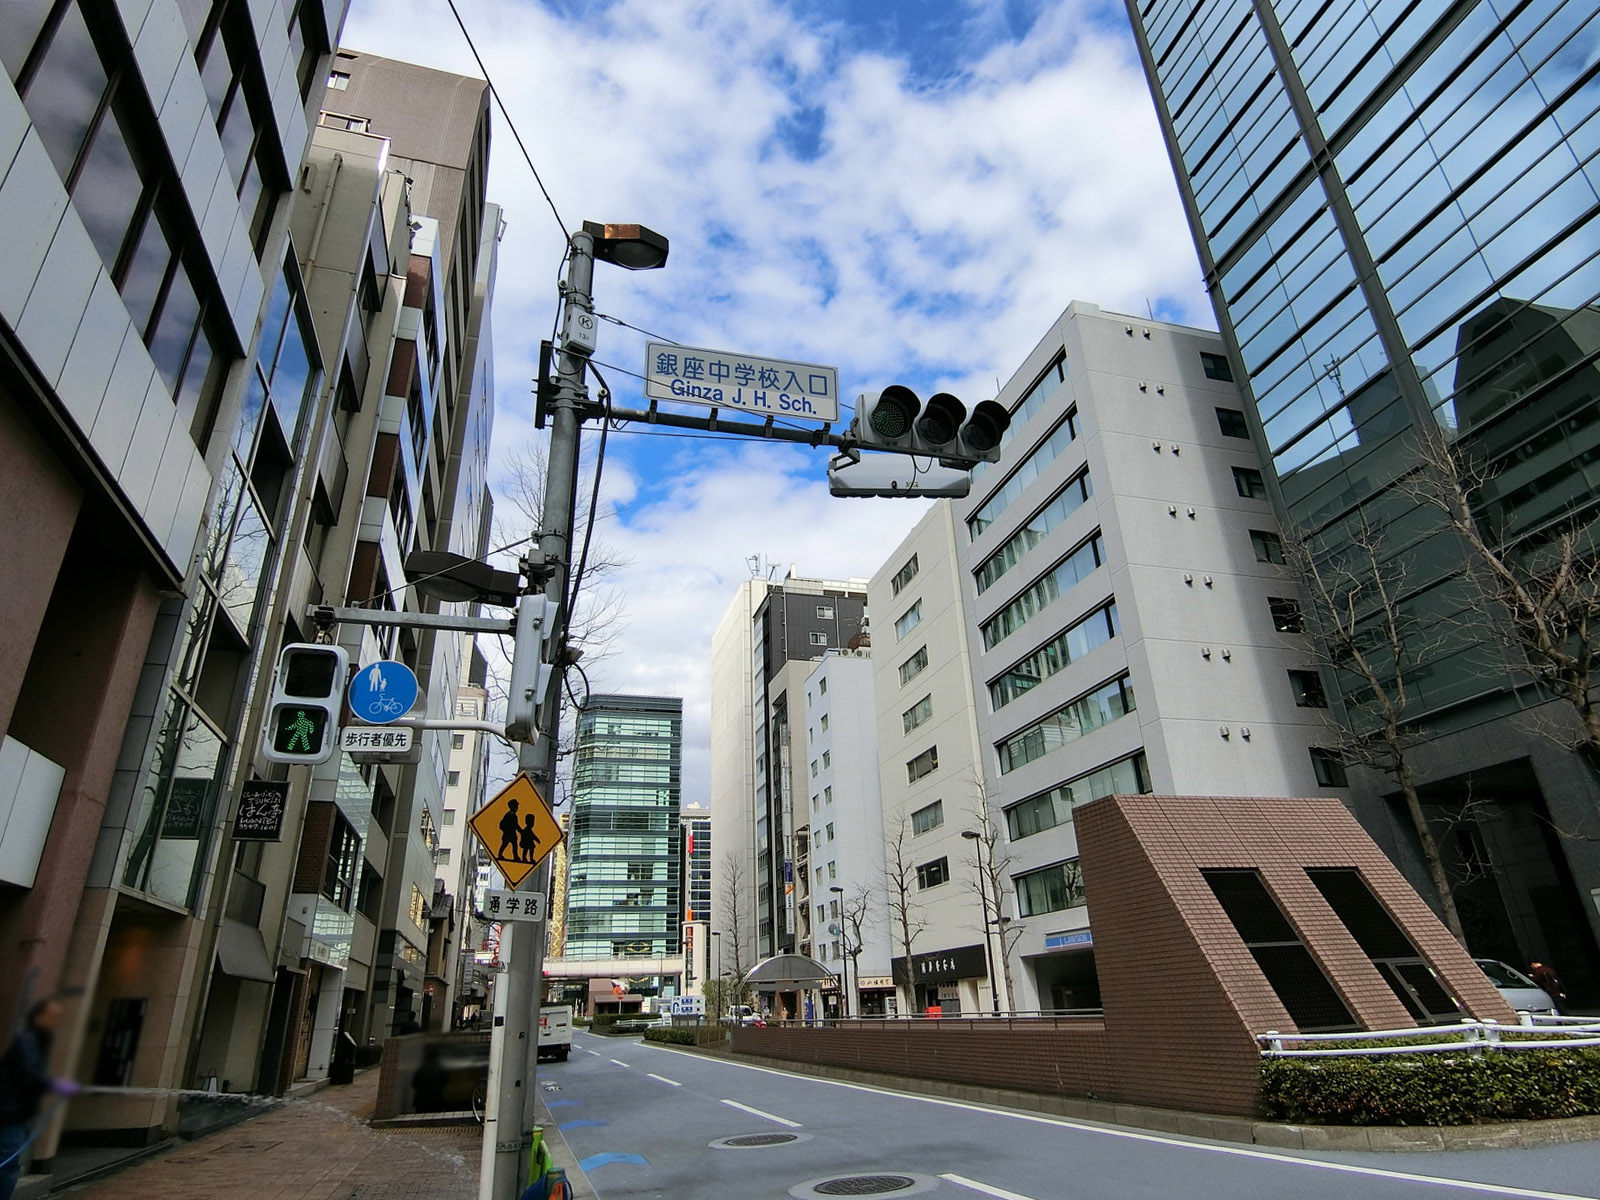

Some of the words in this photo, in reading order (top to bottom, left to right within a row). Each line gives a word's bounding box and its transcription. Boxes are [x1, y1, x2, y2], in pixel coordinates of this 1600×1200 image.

[656, 353, 828, 397] 銀座中学校入口
[671, 379, 723, 402] Ginza
[732, 388, 747, 406] J.
[754, 391, 772, 409] H.
[779, 394, 817, 415] Sch.
[345, 732, 407, 747] 歩行者優先
[489, 895, 538, 916] 通学路
